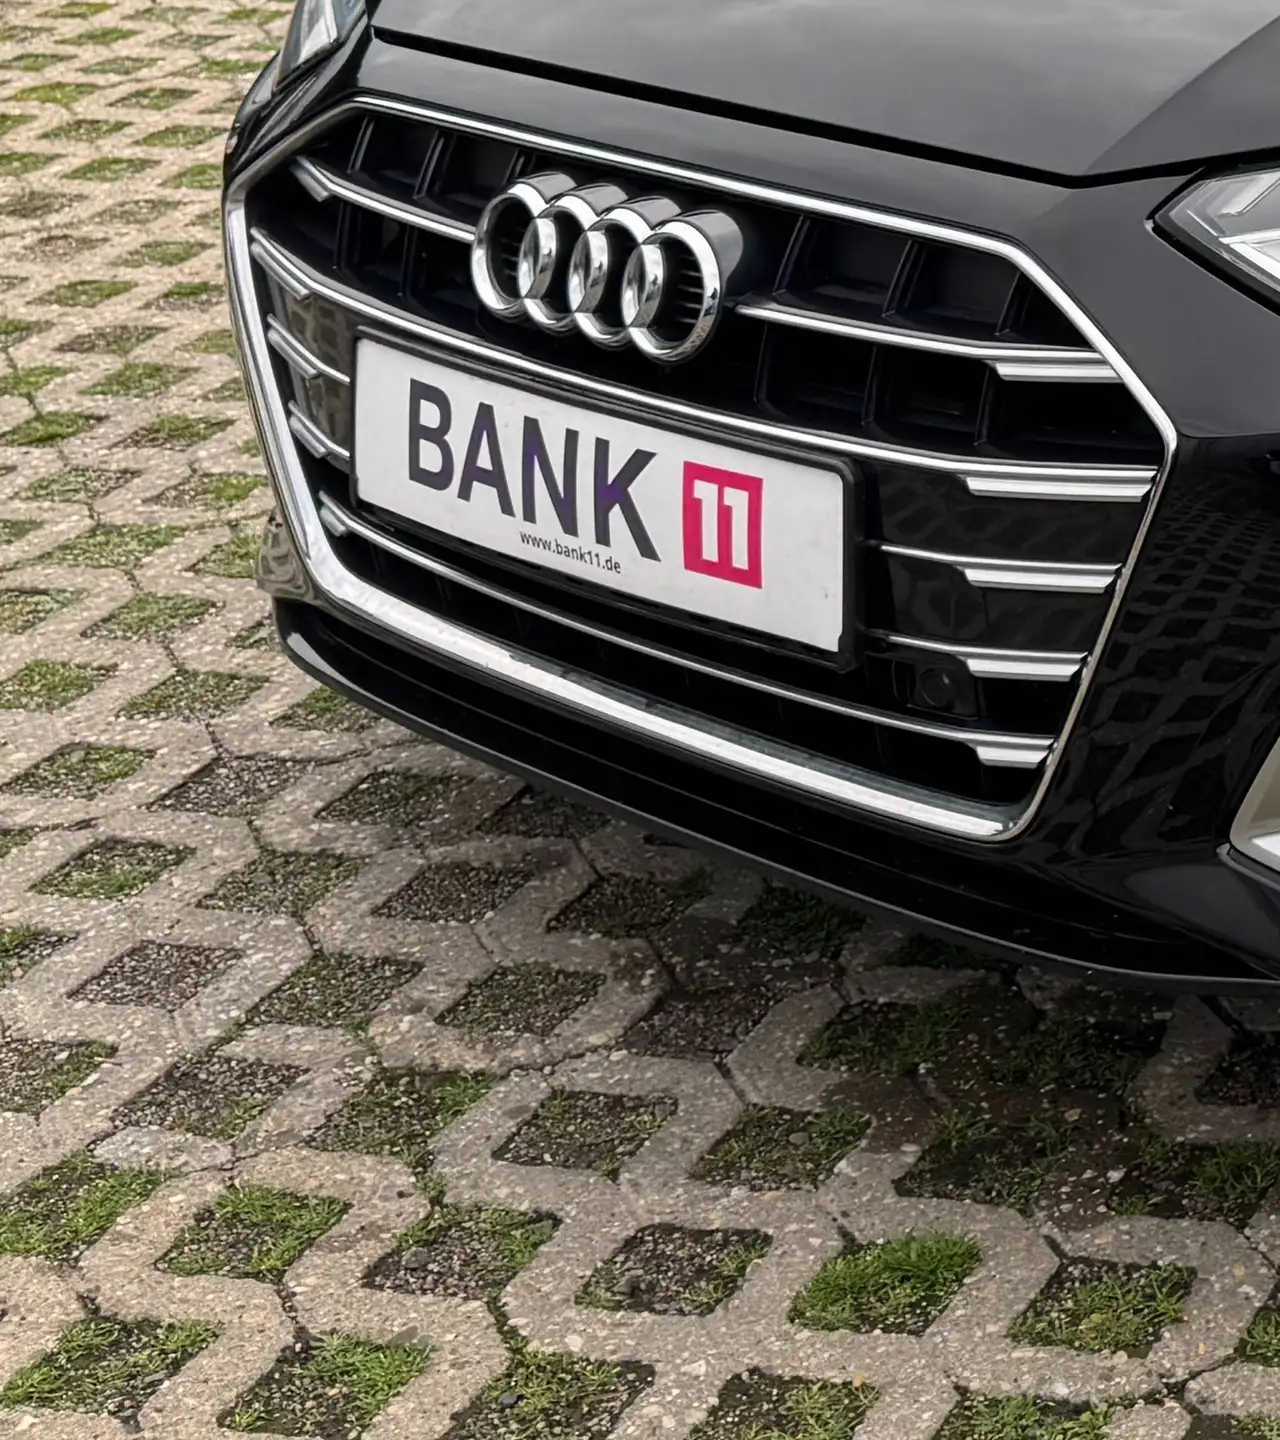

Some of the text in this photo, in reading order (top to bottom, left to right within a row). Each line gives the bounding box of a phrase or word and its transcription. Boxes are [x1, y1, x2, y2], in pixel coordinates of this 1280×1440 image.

[409, 378, 751, 572] BANK 11
[519, 530, 622, 574] www.bank11.de
